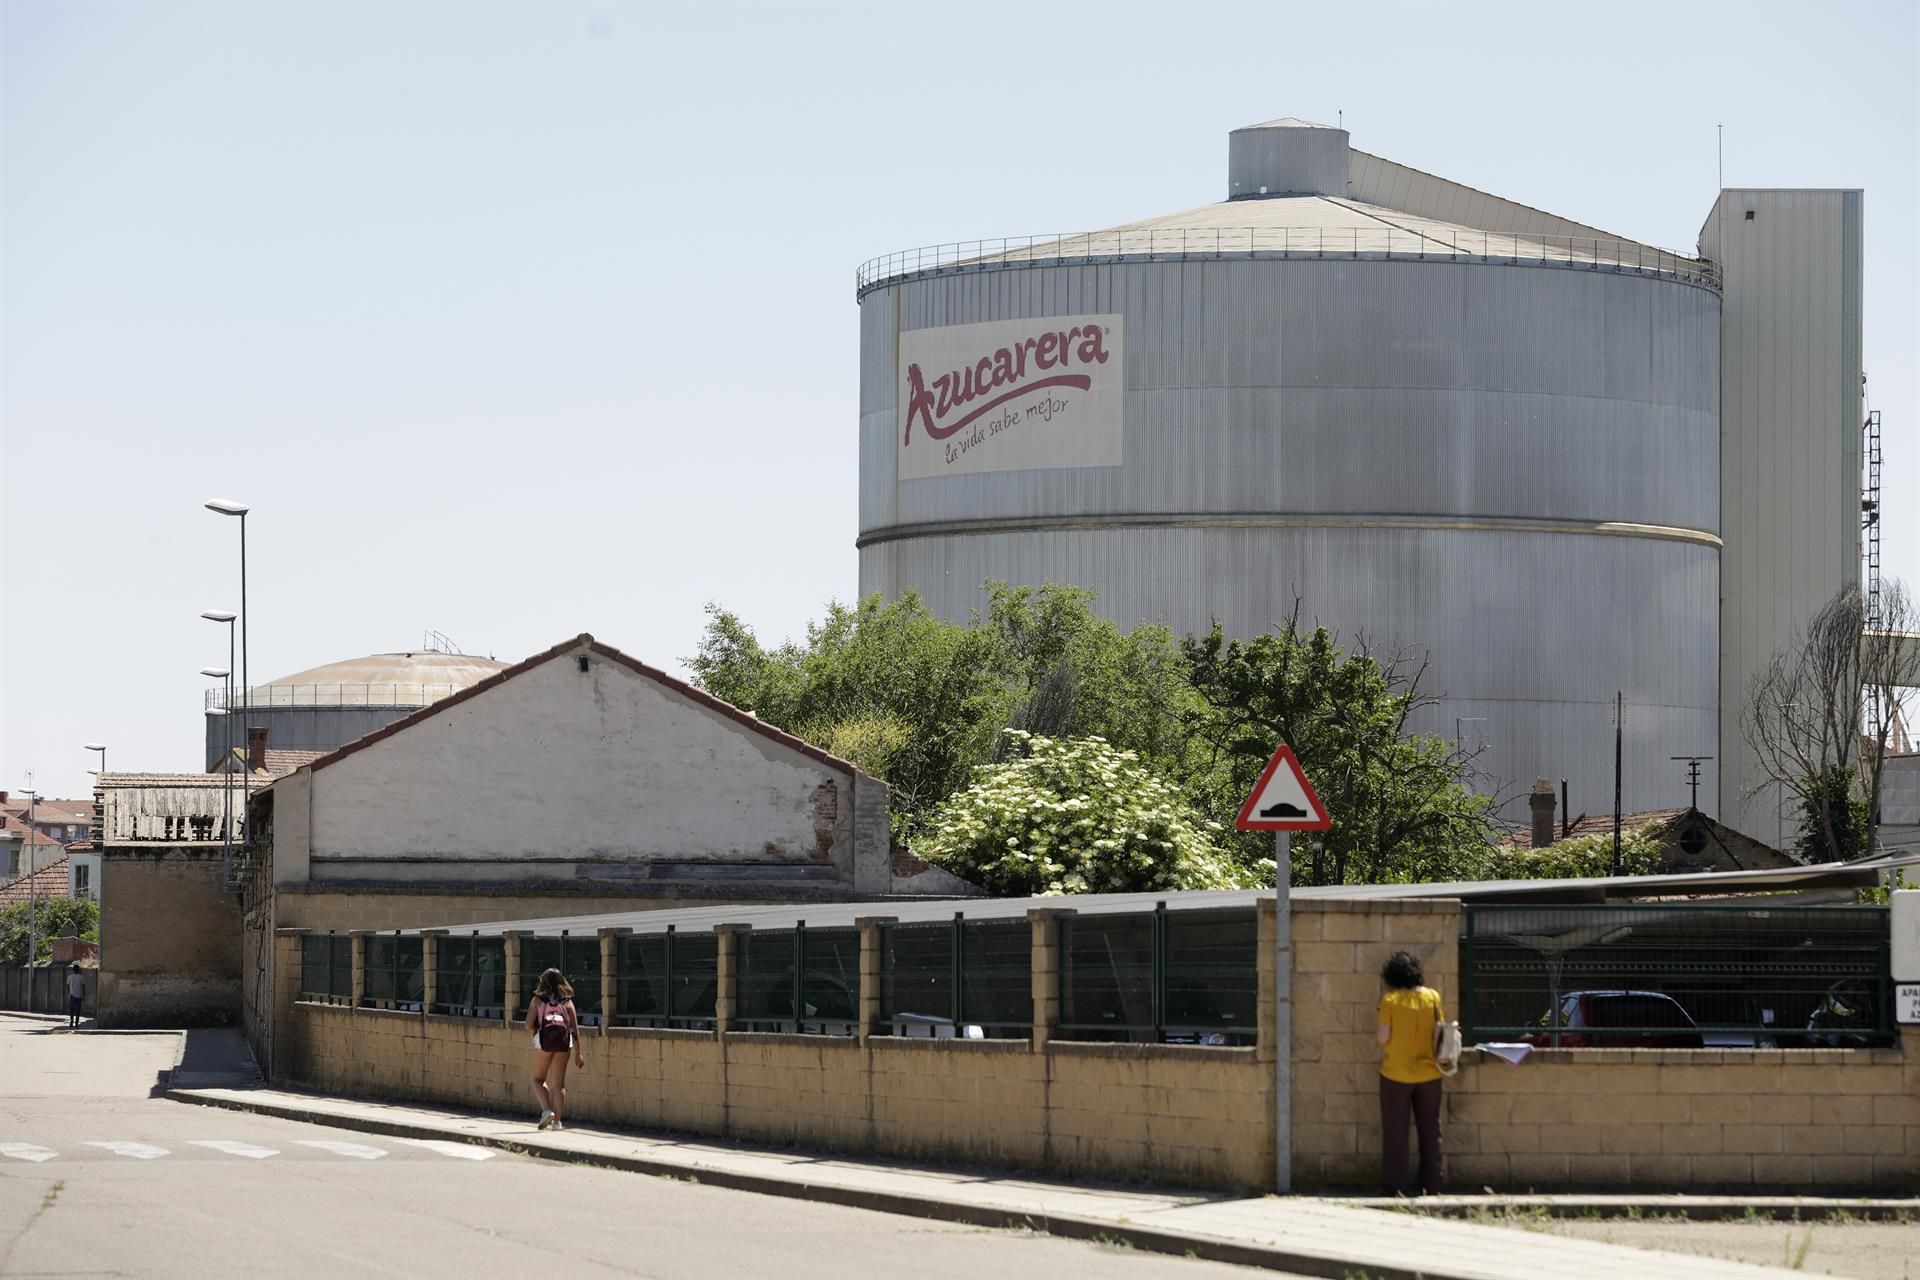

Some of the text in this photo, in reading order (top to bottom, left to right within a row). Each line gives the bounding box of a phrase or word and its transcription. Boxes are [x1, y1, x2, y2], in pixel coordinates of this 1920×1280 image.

[905, 324, 1109, 447] Azucarera
[945, 389, 1069, 464] la vida sabe mejor
[1901, 988, 1920, 997] APA
